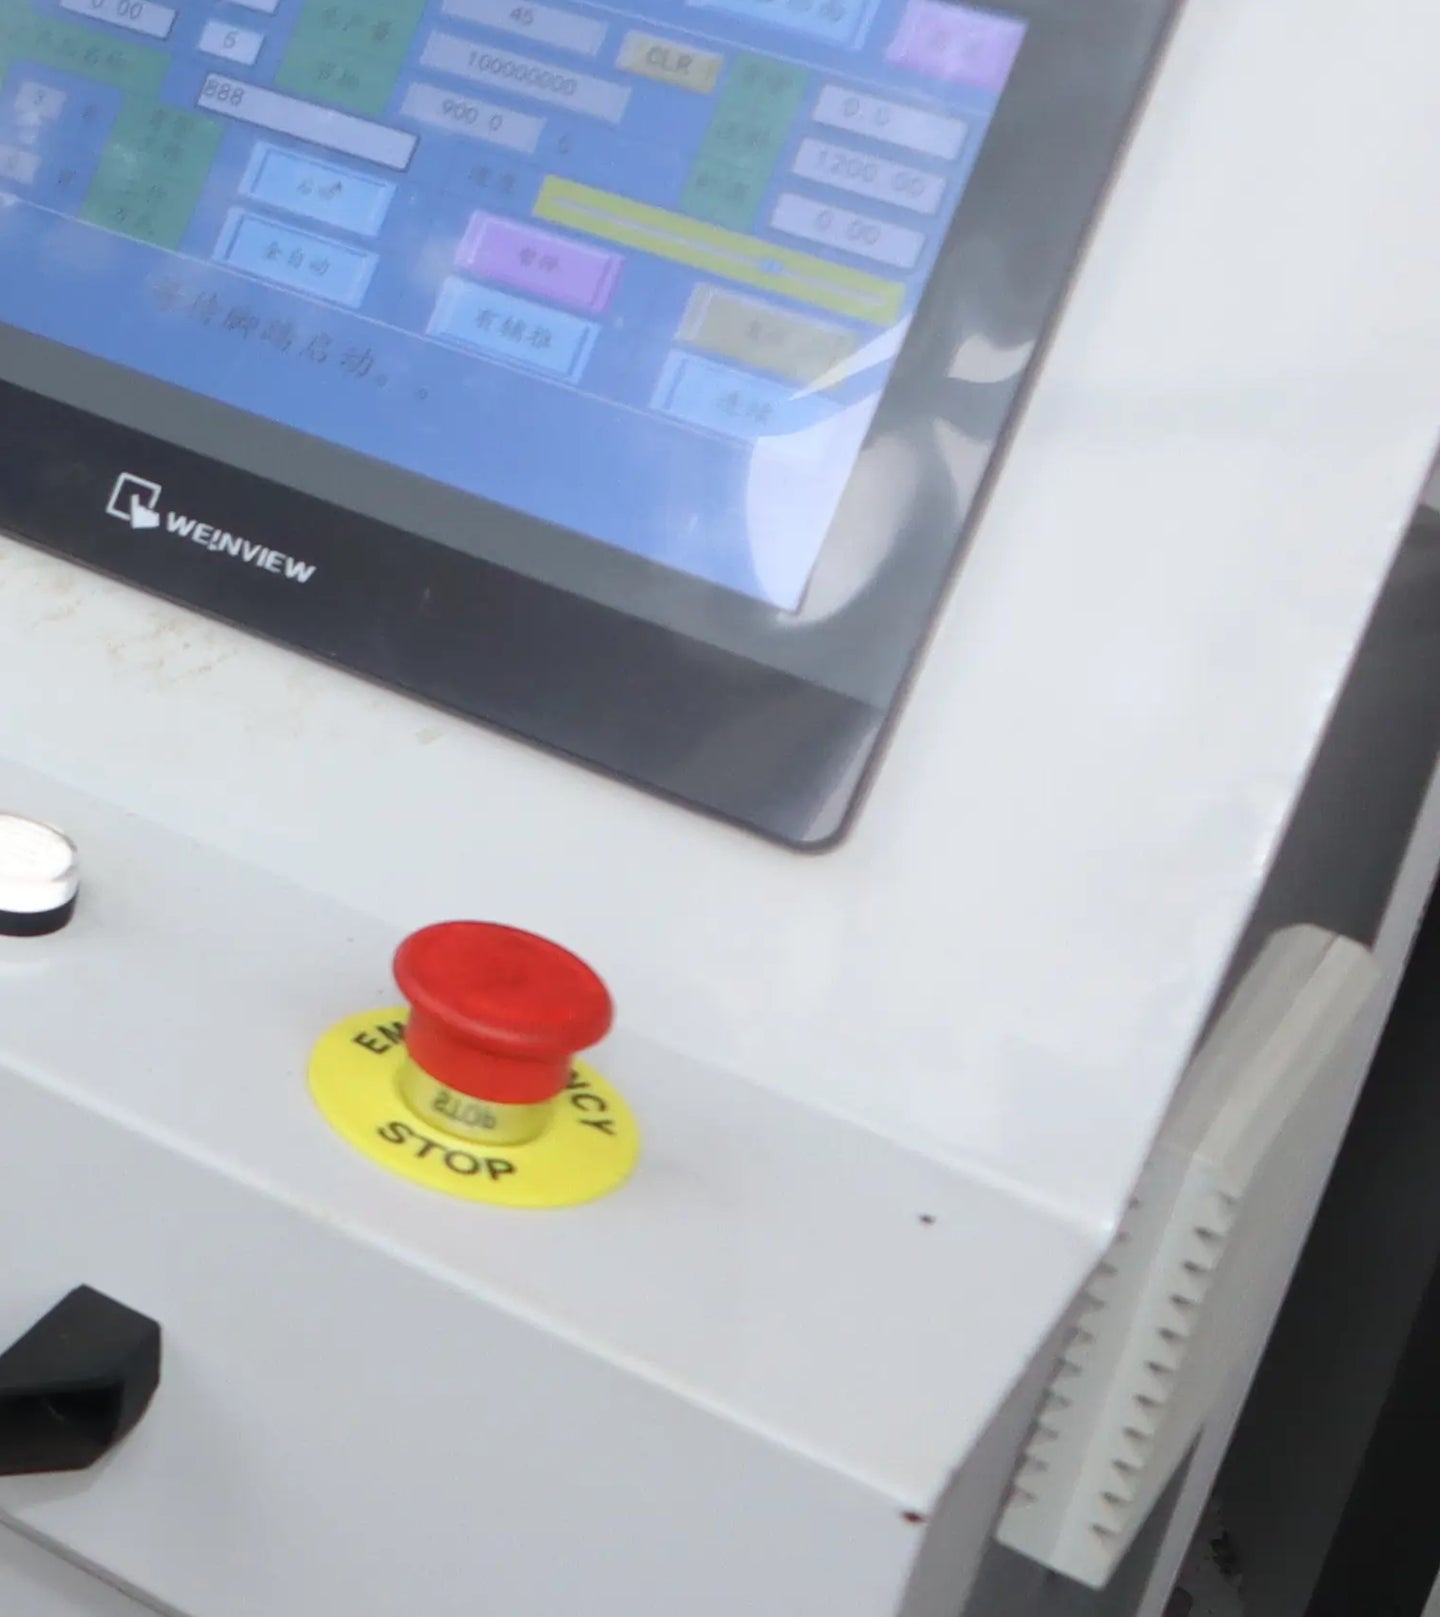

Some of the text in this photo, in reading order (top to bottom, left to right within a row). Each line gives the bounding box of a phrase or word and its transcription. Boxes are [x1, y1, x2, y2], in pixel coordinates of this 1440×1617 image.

[645, 43, 693, 75] CLR
[204, 78, 245, 108] 888
[377, 1120, 518, 1182] STOP
